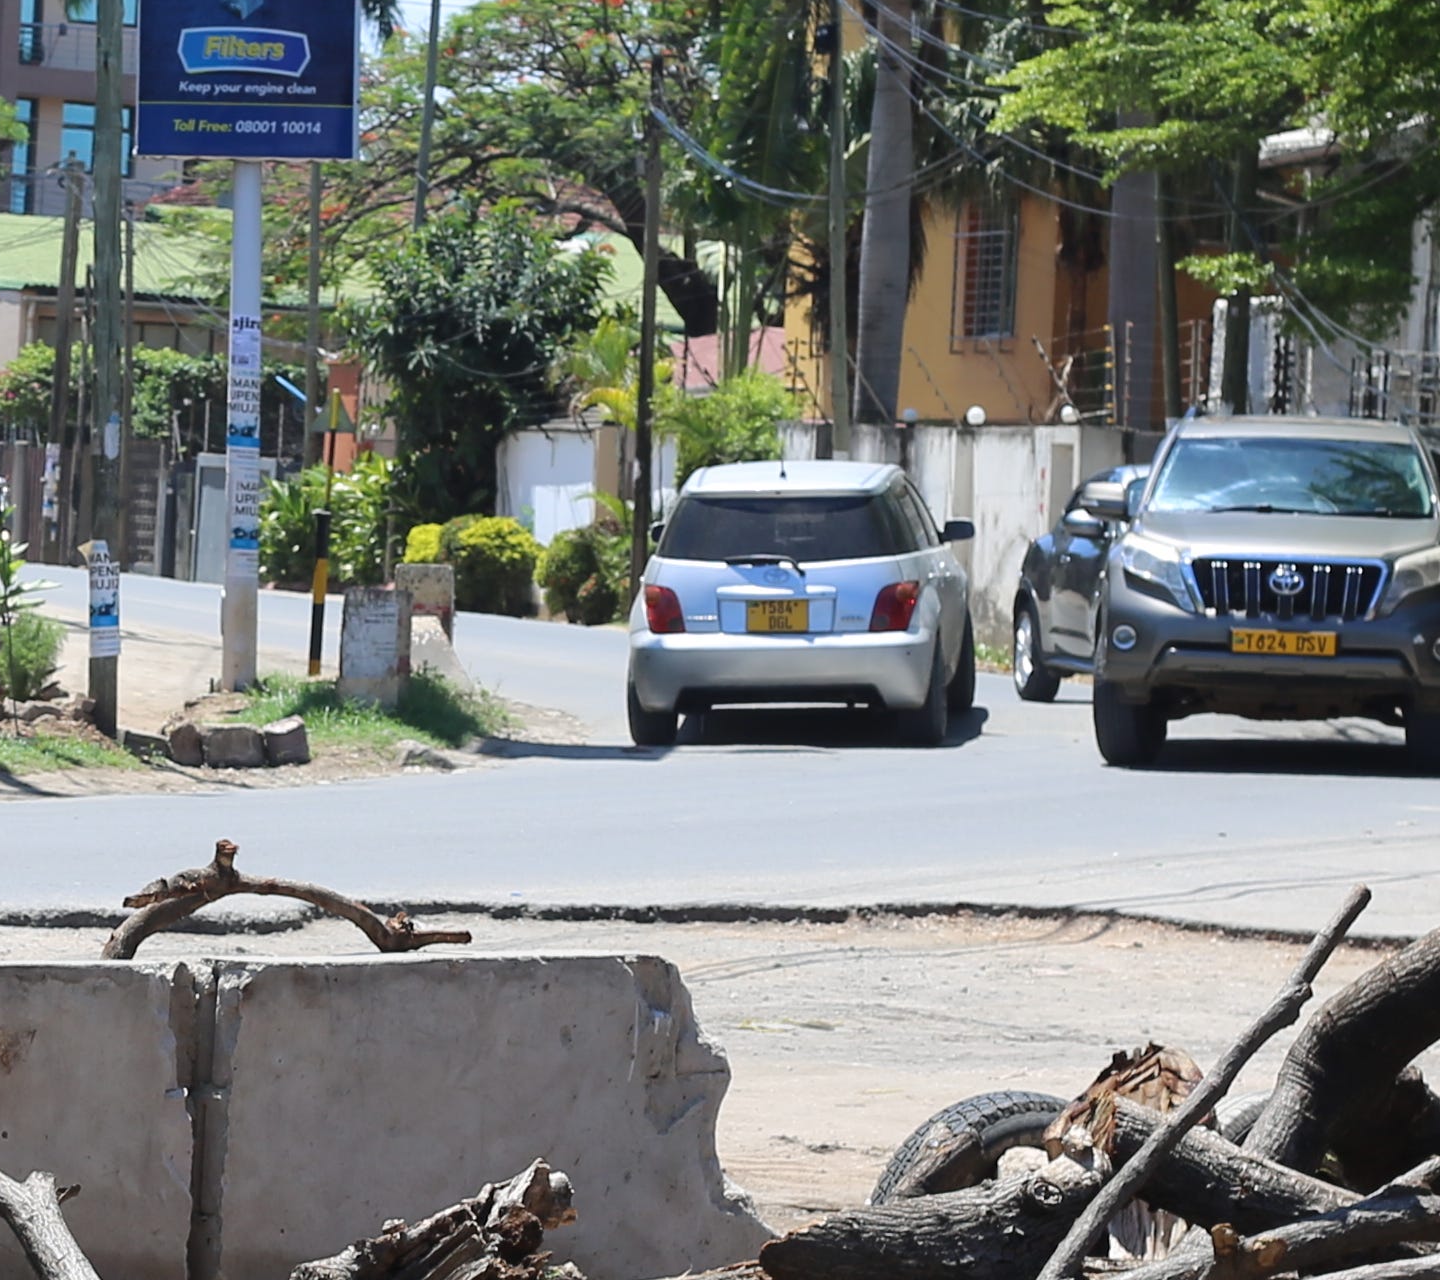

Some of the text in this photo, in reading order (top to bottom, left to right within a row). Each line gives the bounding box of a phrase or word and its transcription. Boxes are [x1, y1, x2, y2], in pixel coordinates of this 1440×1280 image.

[204, 35, 285, 60] Filters
[179, 80, 316, 96] Keep your engine clean
[173, 119, 322, 134] Toll Free: 08001 10014
[761, 600, 793, 615] T584
[768, 615, 793, 630] DGL
[1296, 635, 1328, 653] DSV
